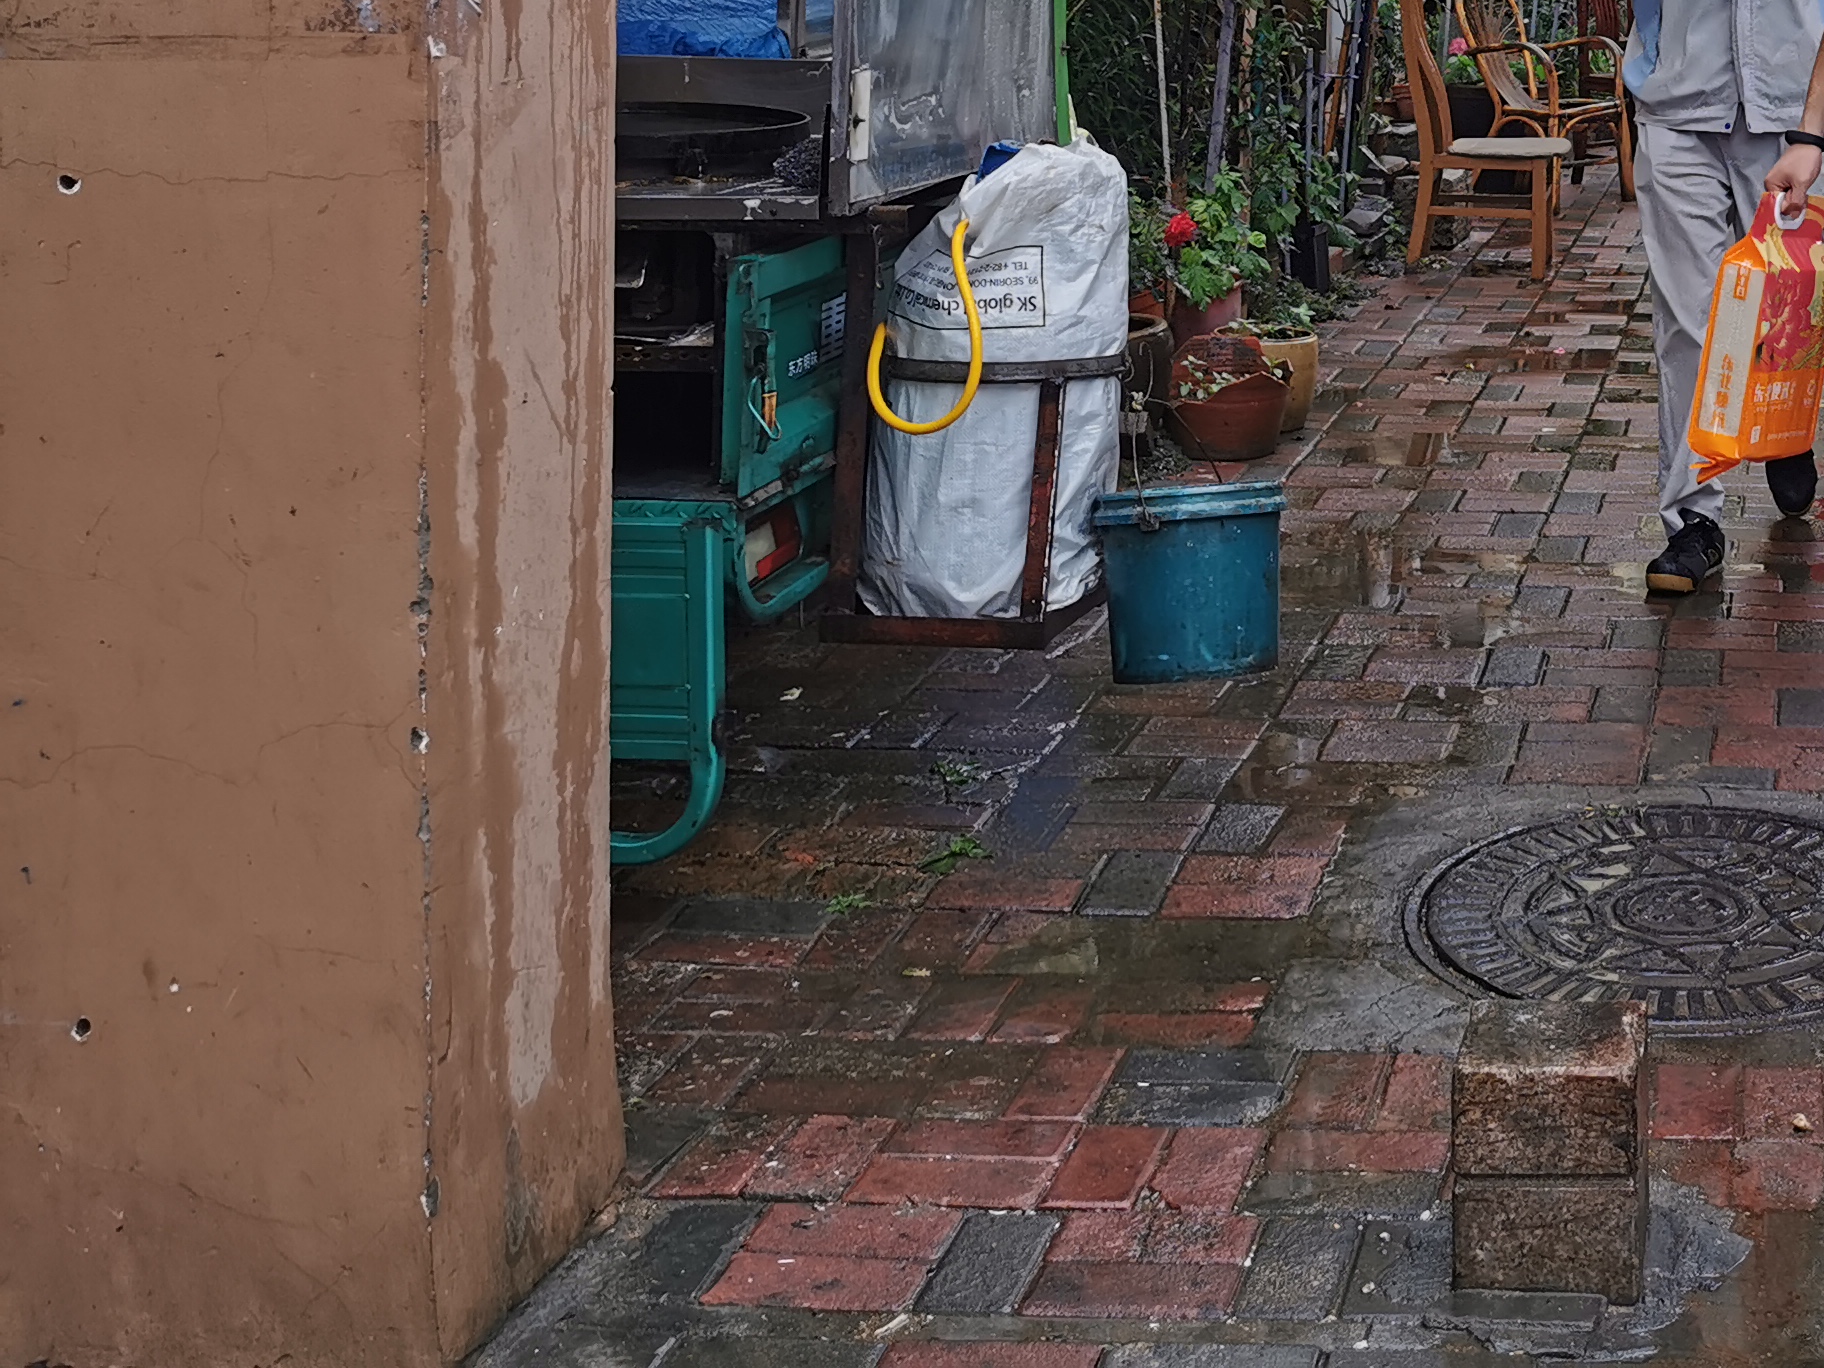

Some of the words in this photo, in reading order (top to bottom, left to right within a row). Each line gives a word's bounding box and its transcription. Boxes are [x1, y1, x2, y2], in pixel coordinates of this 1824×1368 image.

[1012, 261, 1029, 270] TEL
[912, 291, 961, 316] chemical
[1017, 295, 1038, 313] SK
